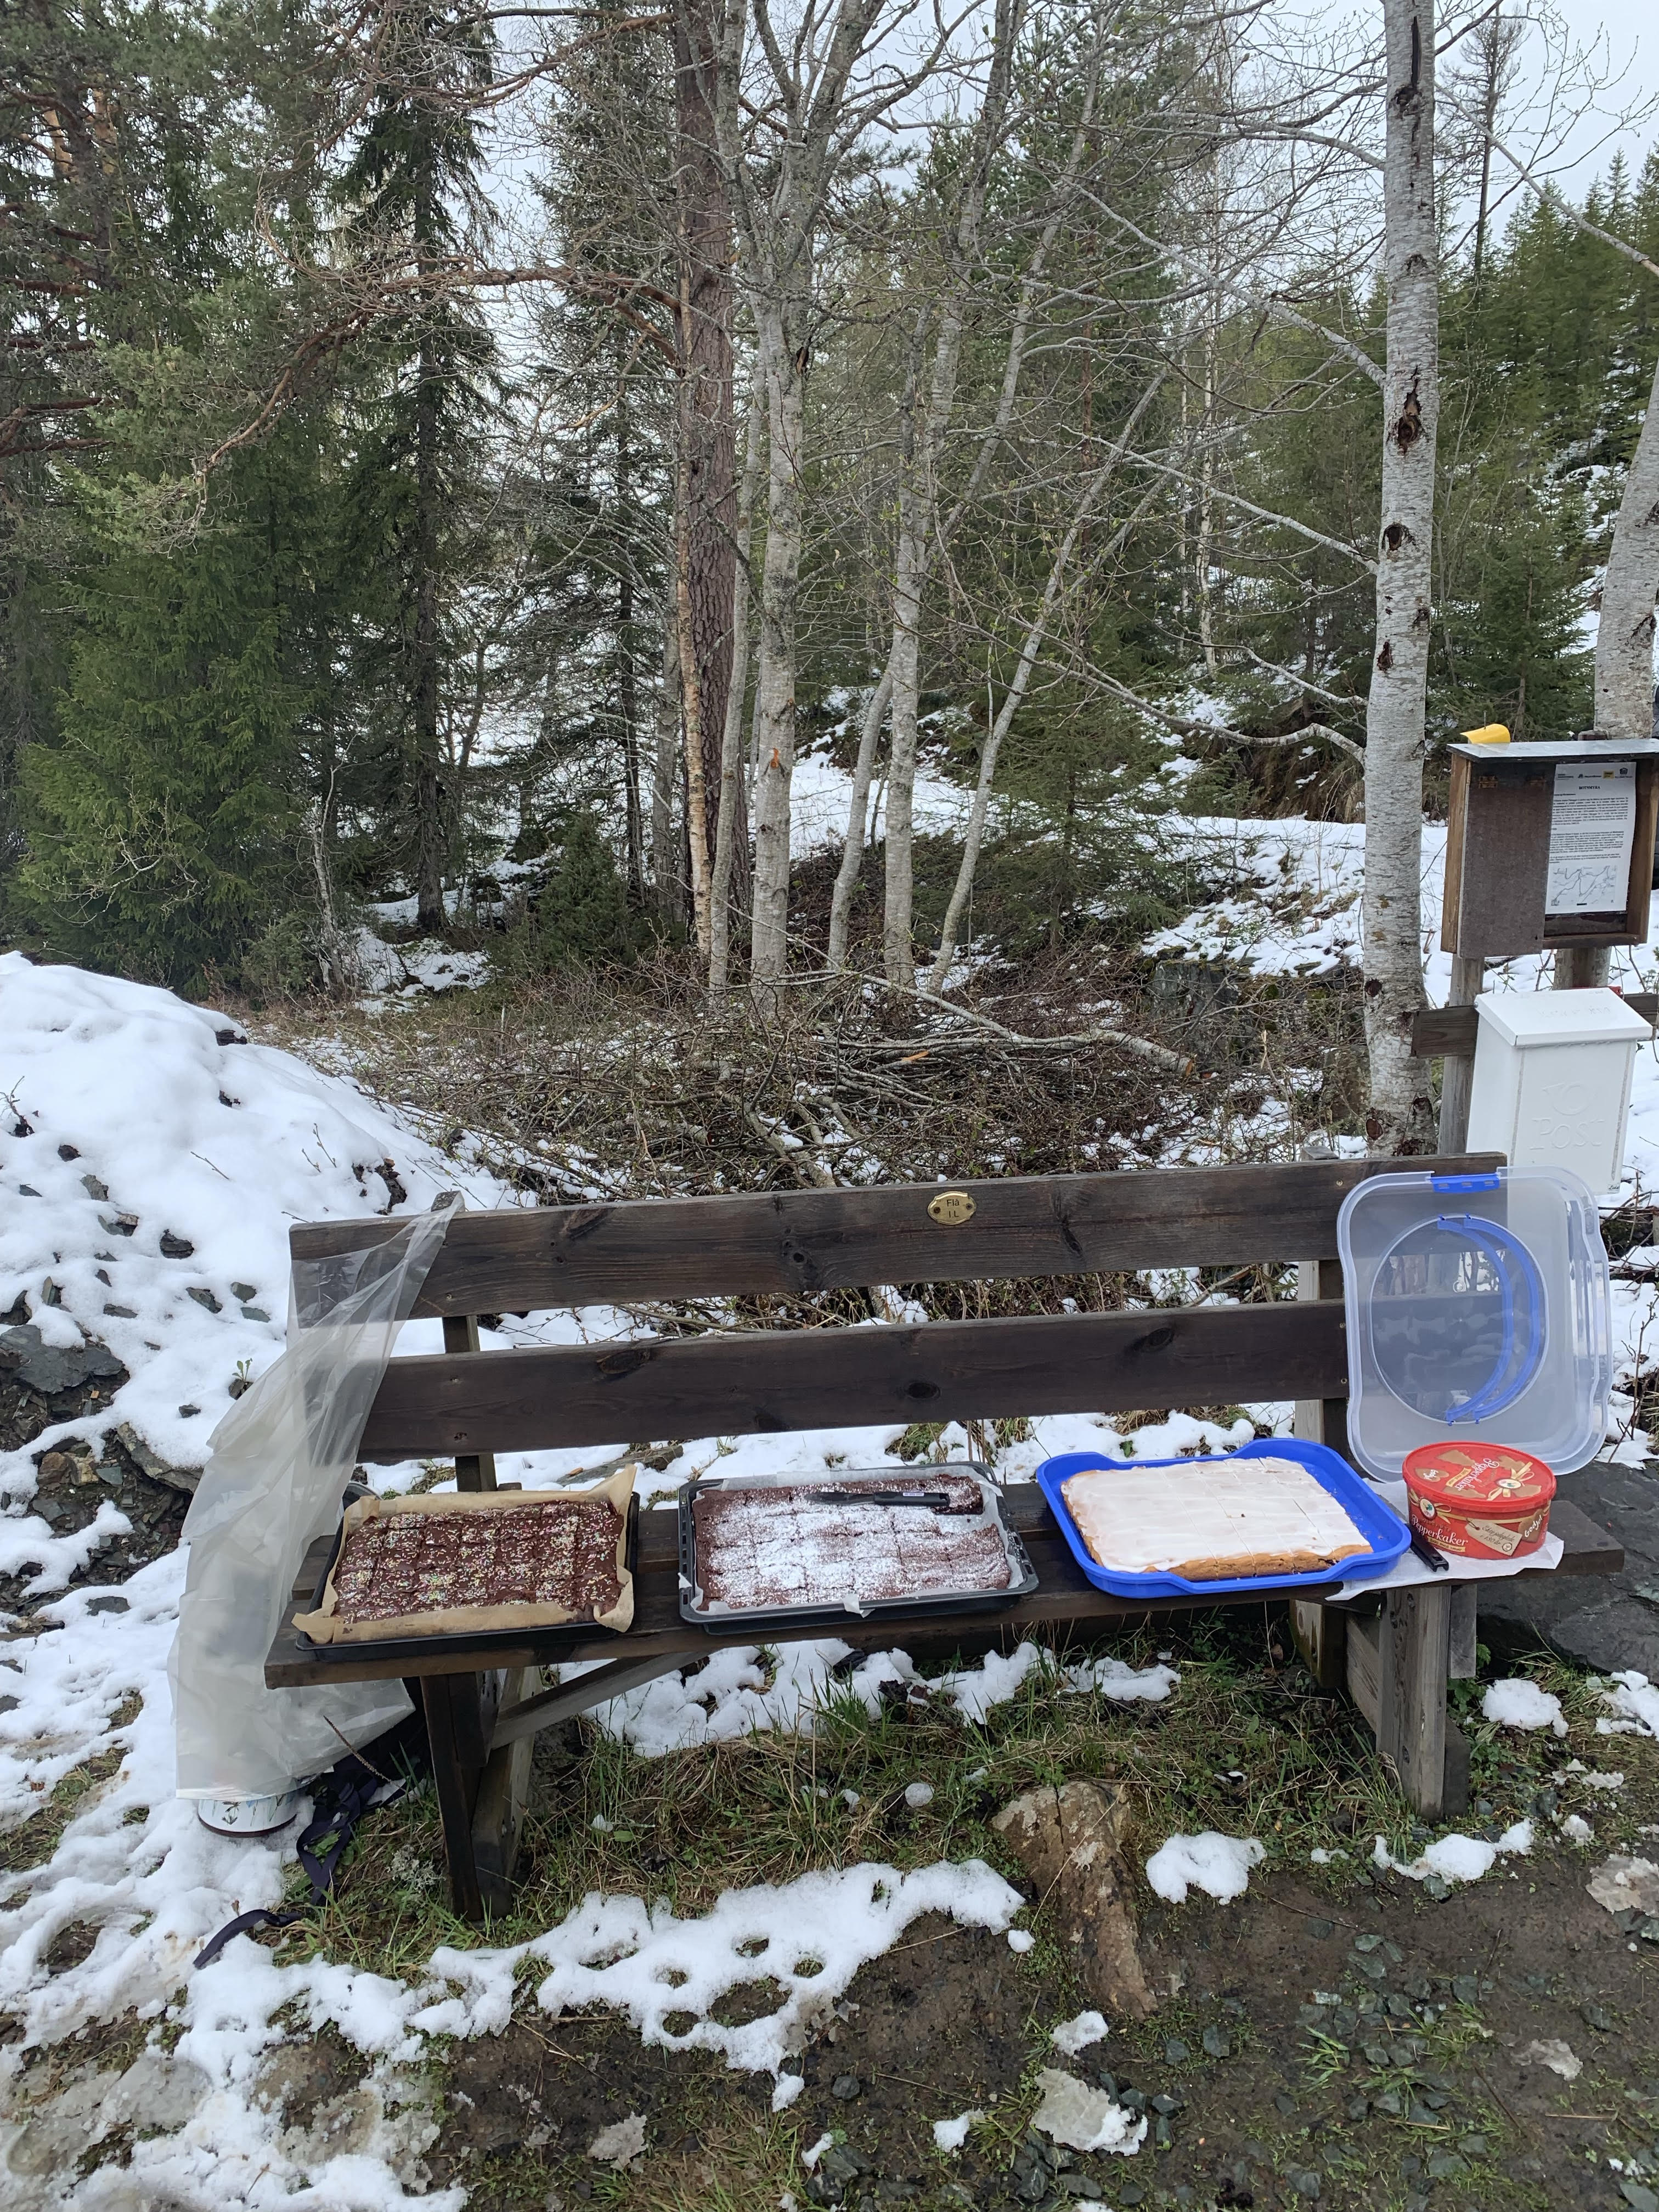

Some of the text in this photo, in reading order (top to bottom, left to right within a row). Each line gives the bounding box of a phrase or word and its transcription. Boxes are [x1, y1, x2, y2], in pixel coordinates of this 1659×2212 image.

[946, 1198, 960, 1207] Flå
[1454, 1458, 1500, 1491] Pepperkaker
[1412, 1514, 1469, 1546] Pepperkaker
